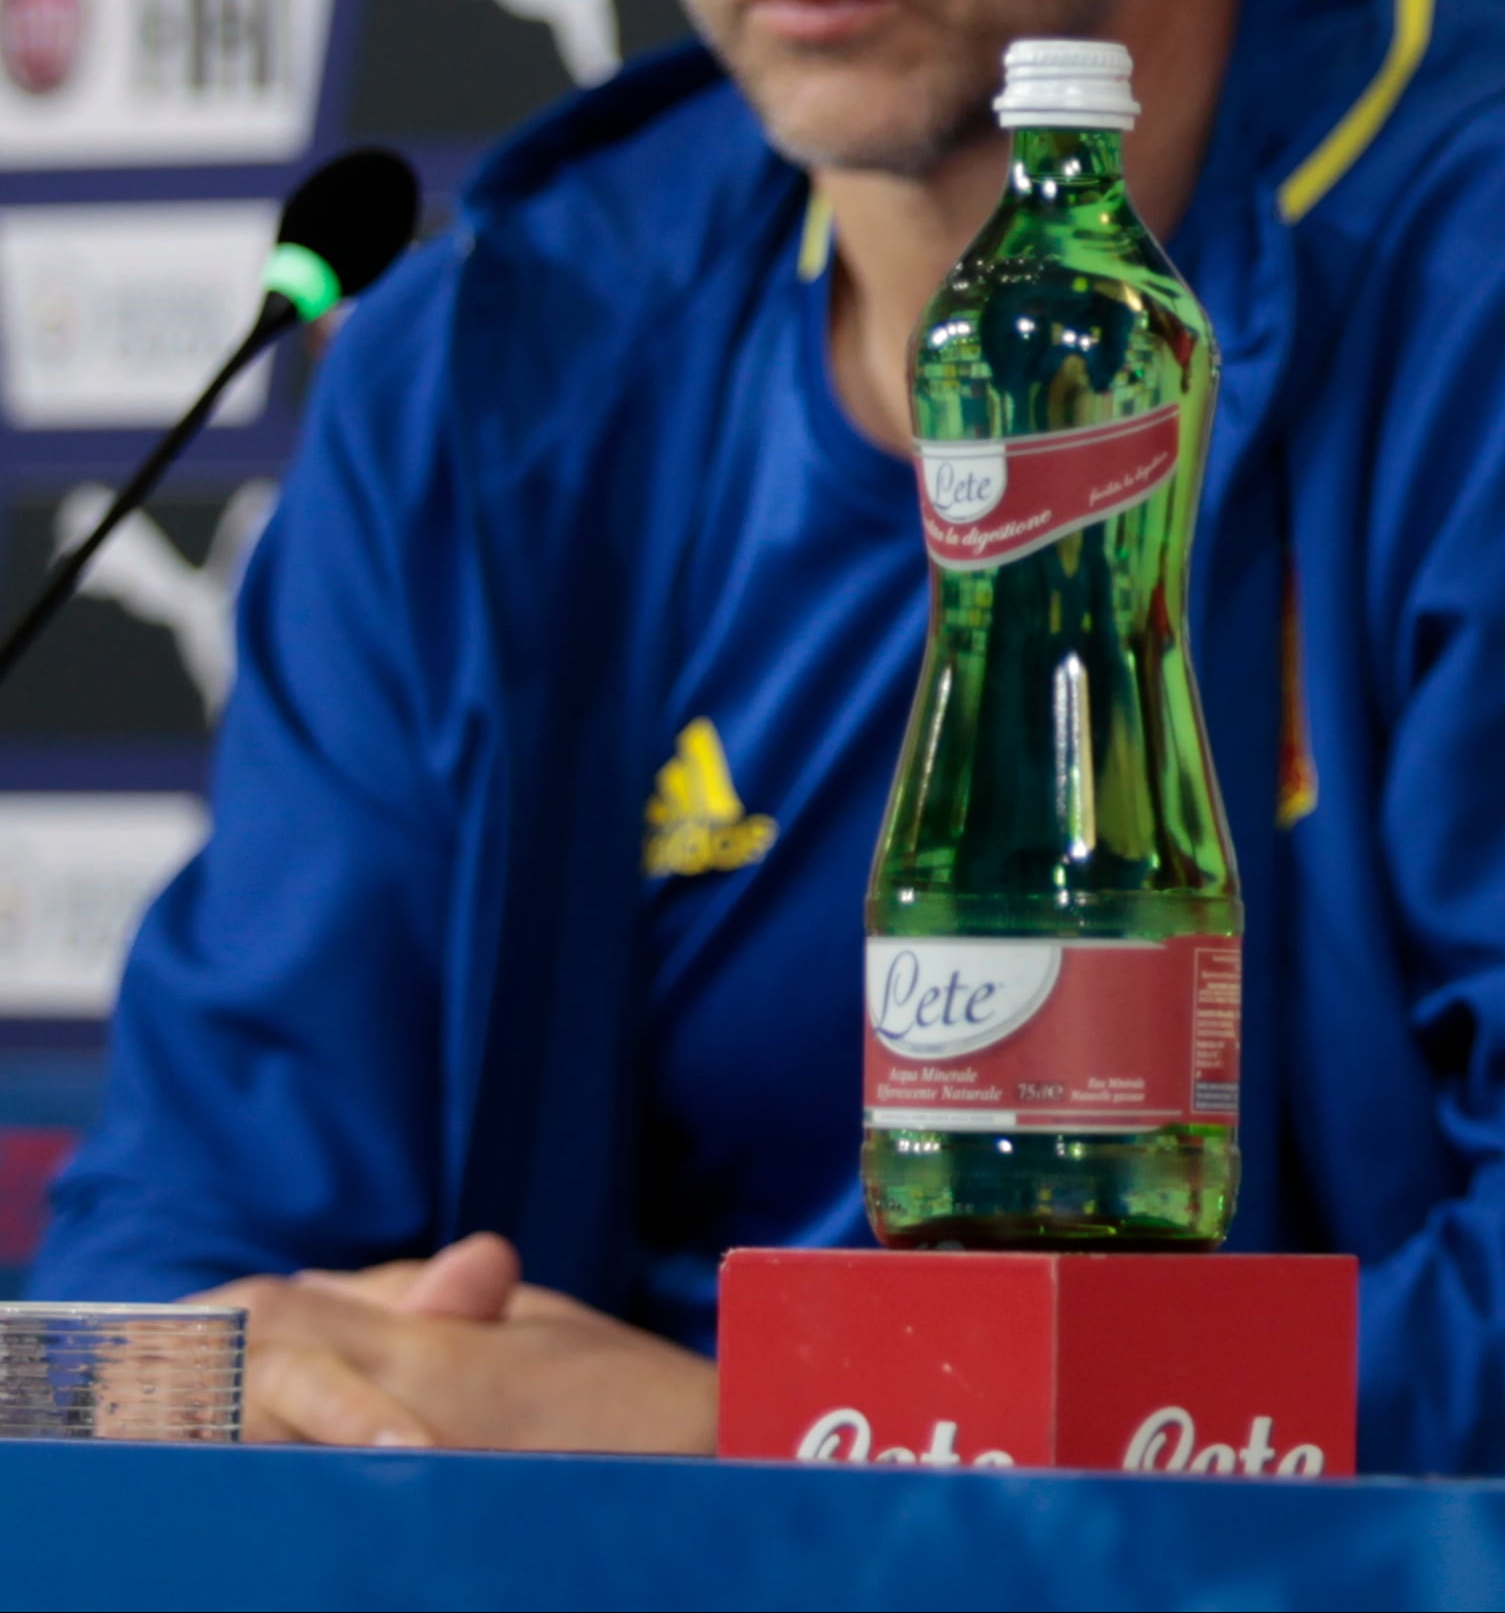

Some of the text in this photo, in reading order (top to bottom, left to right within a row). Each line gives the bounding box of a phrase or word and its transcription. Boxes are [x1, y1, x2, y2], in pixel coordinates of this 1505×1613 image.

[931, 462, 993, 510] Lete
[962, 508, 1052, 556] digestione
[876, 950, 1003, 1038] Lete
[920, 1067, 978, 1083] Minerale
